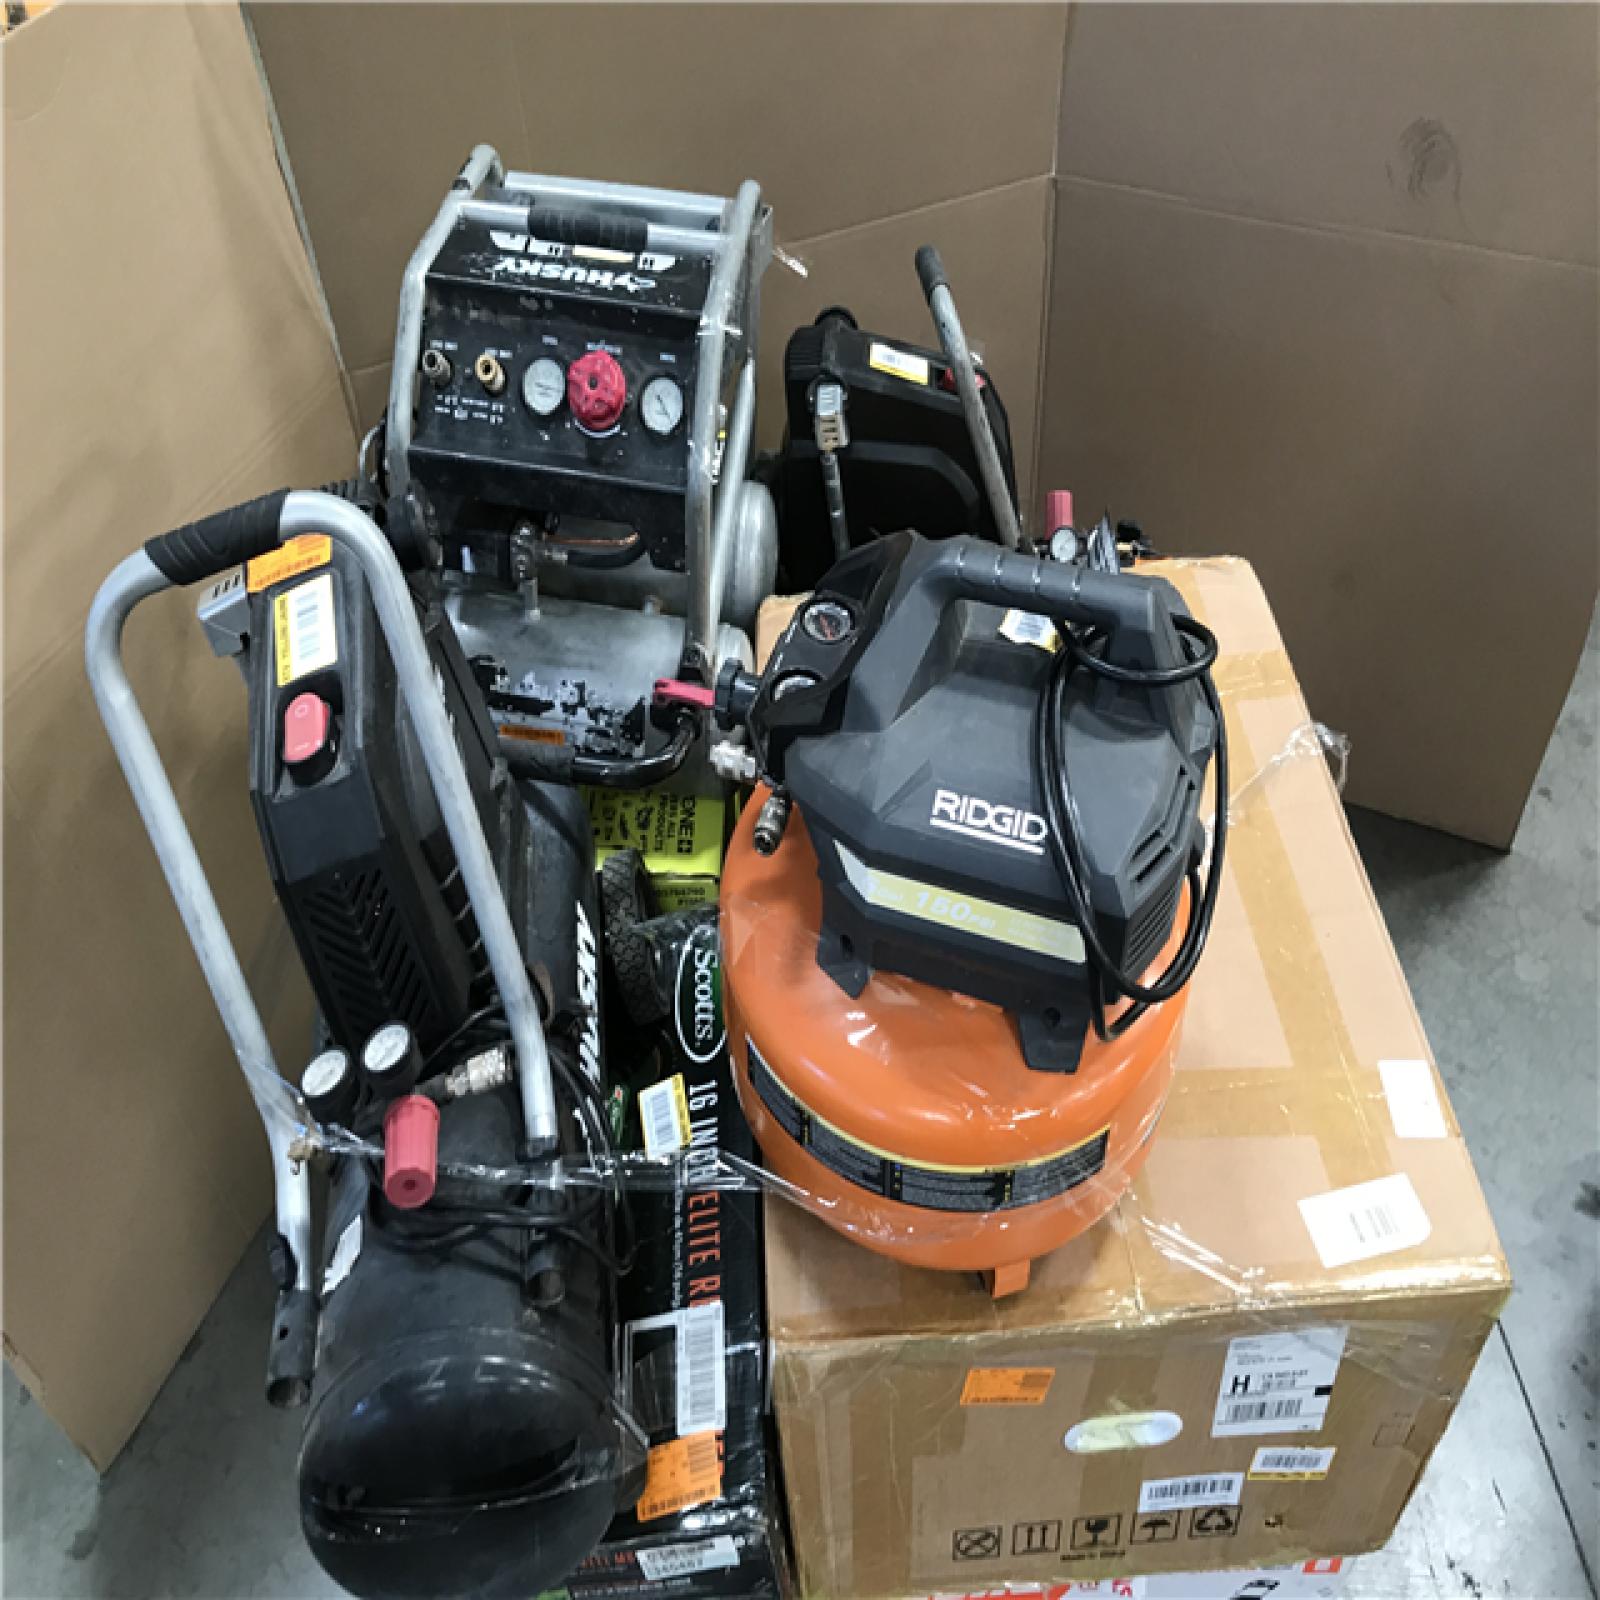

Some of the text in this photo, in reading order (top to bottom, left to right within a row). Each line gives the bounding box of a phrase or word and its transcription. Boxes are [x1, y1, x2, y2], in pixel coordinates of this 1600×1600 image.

[932, 789, 1048, 841] RIDGID
[695, 947, 718, 1040] Scotts
[690, 1080, 718, 1111] 16
[690, 1117, 718, 1183] INCH
[689, 1191, 720, 1266] ELITE
[1231, 1374, 1251, 1395] H
